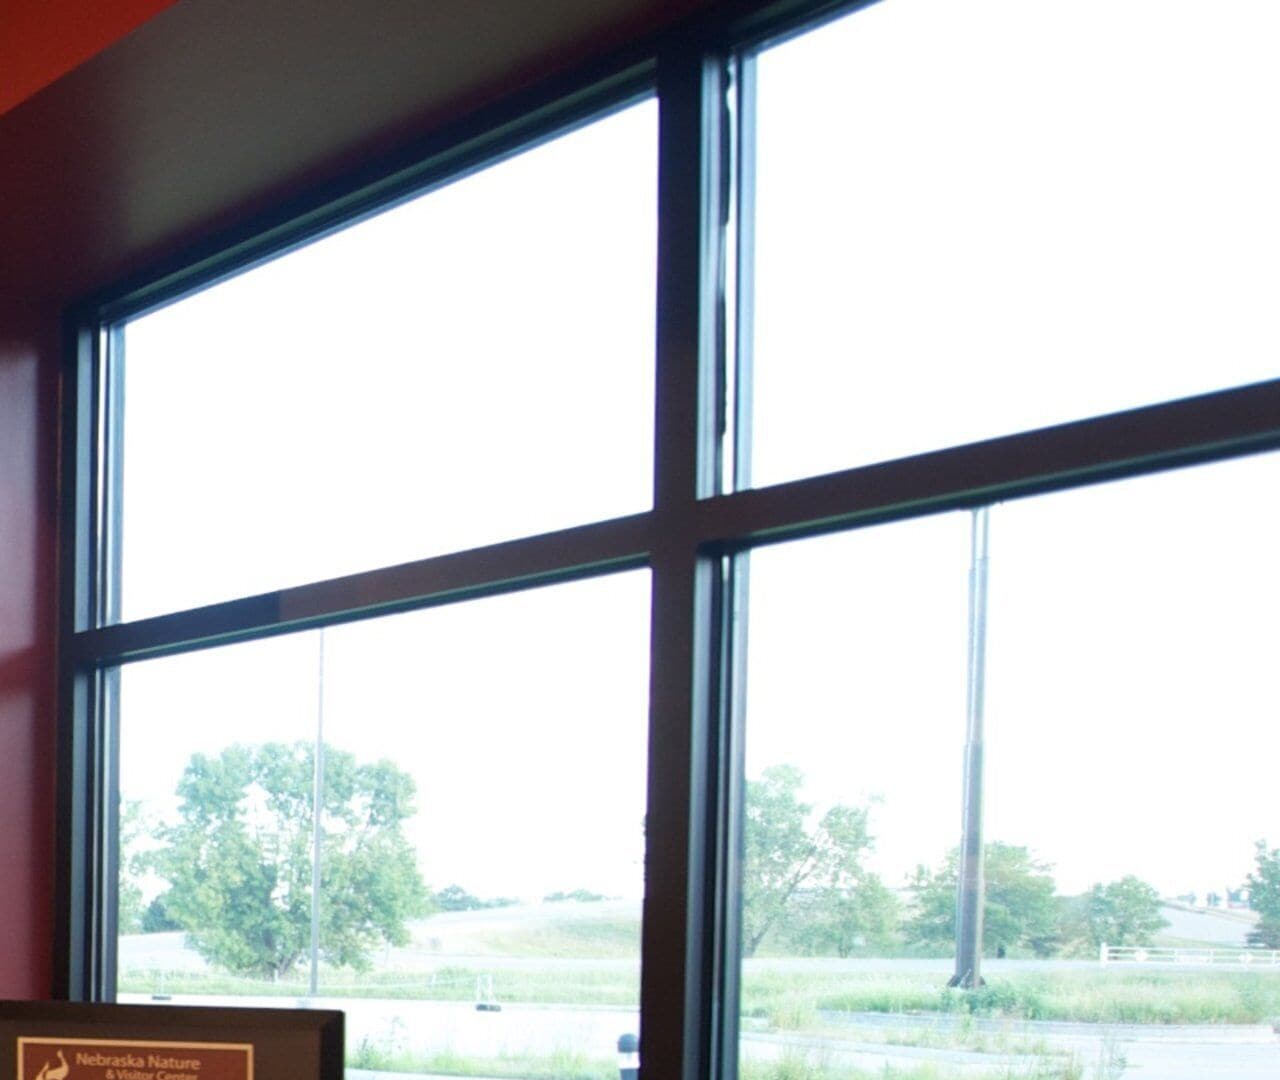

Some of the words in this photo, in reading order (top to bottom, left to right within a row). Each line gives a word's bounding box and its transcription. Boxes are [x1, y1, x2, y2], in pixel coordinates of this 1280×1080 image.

[76, 1052, 144, 1068] Nebraska
[148, 1055, 200, 1070] Nature
[105, 1069, 115, 1080] &
[116, 1069, 154, 1080] Visitor
